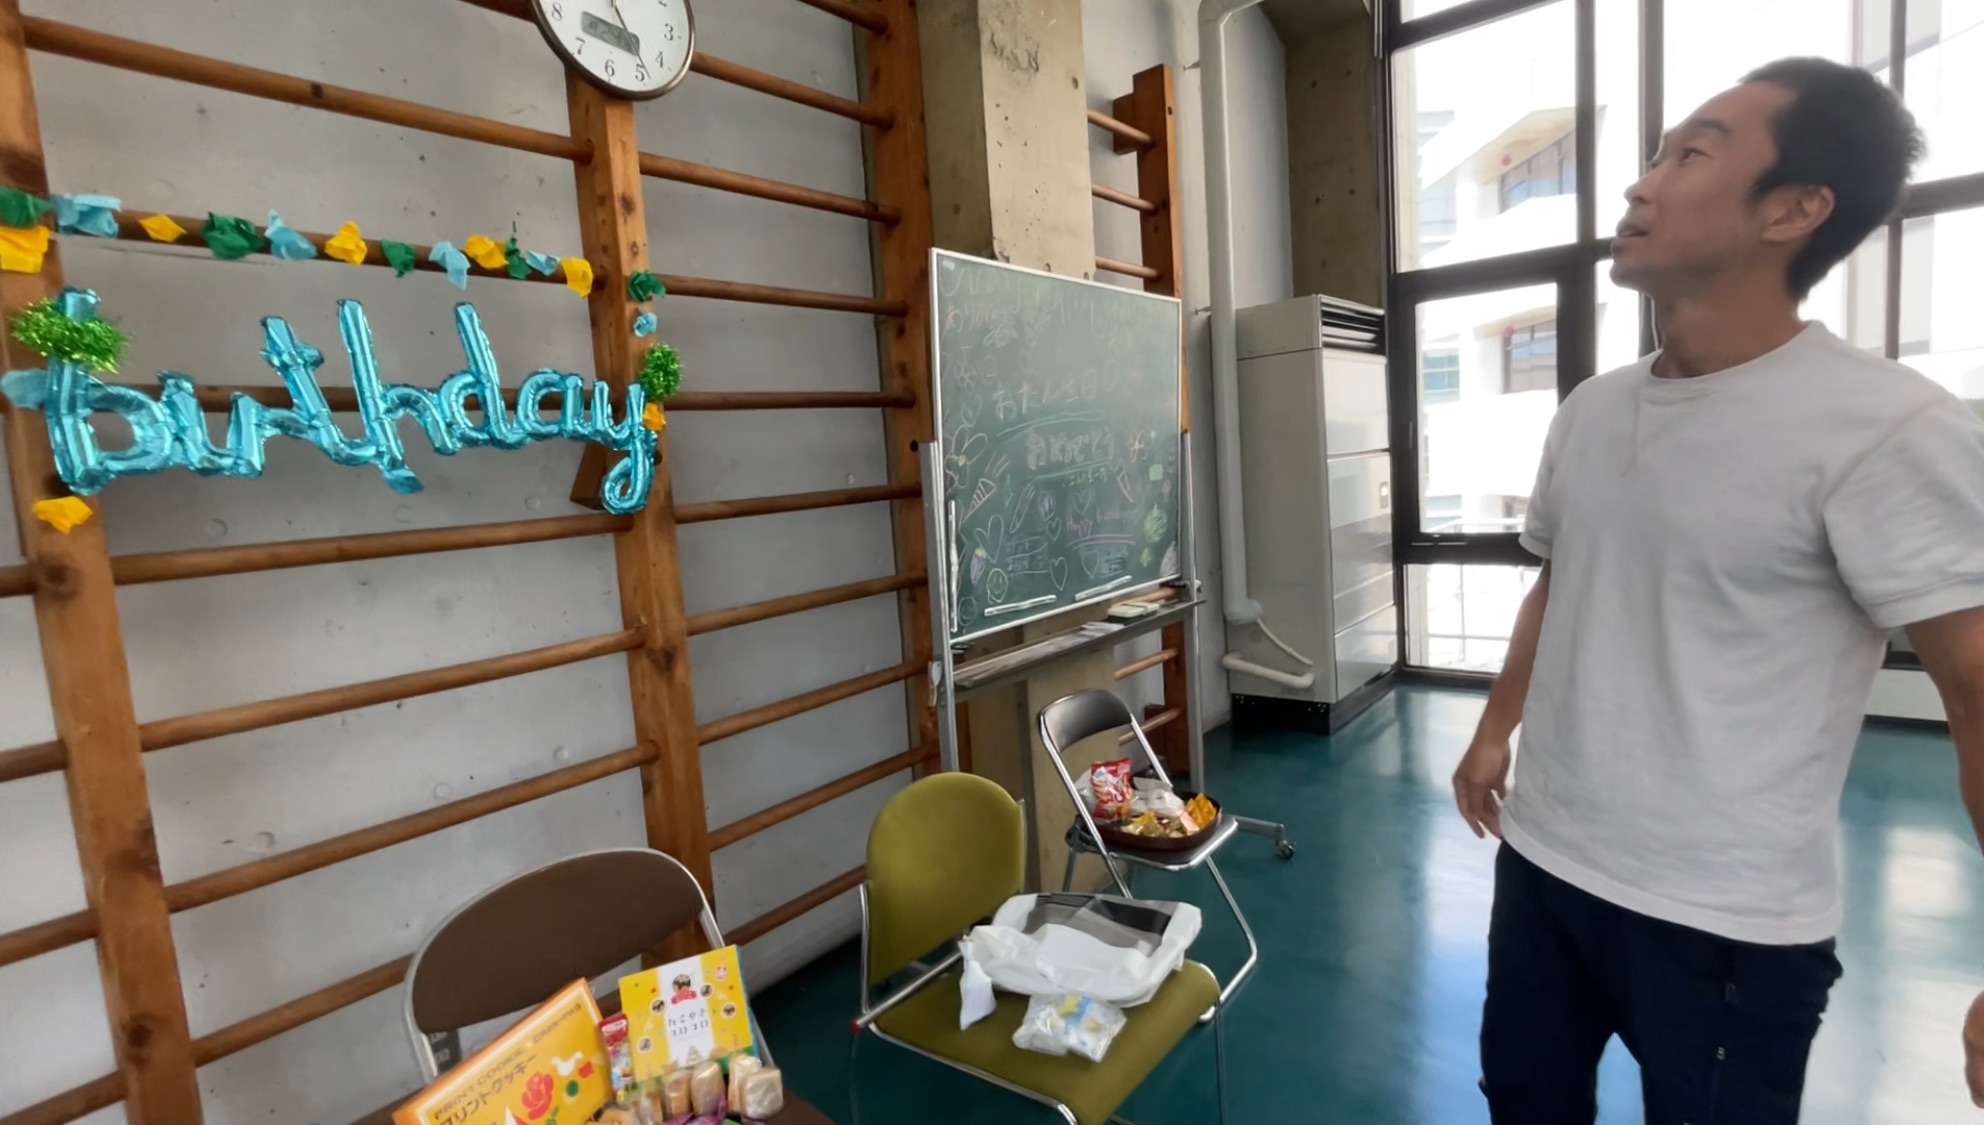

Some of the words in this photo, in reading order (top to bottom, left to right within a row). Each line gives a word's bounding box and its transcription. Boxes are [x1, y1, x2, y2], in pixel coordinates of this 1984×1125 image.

[551, 3, 563, 22] 8
[664, 23, 674, 41] 3
[575, 37, 586, 56] 7
[605, 59, 615, 77] 6
[656, 51, 664, 68] 4
[635, 63, 646, 82] 5
[47, 288, 657, 515] birthday
[434, 1083, 476, 1120] PRINT
[476, 1047, 523, 1084] COOKIE
